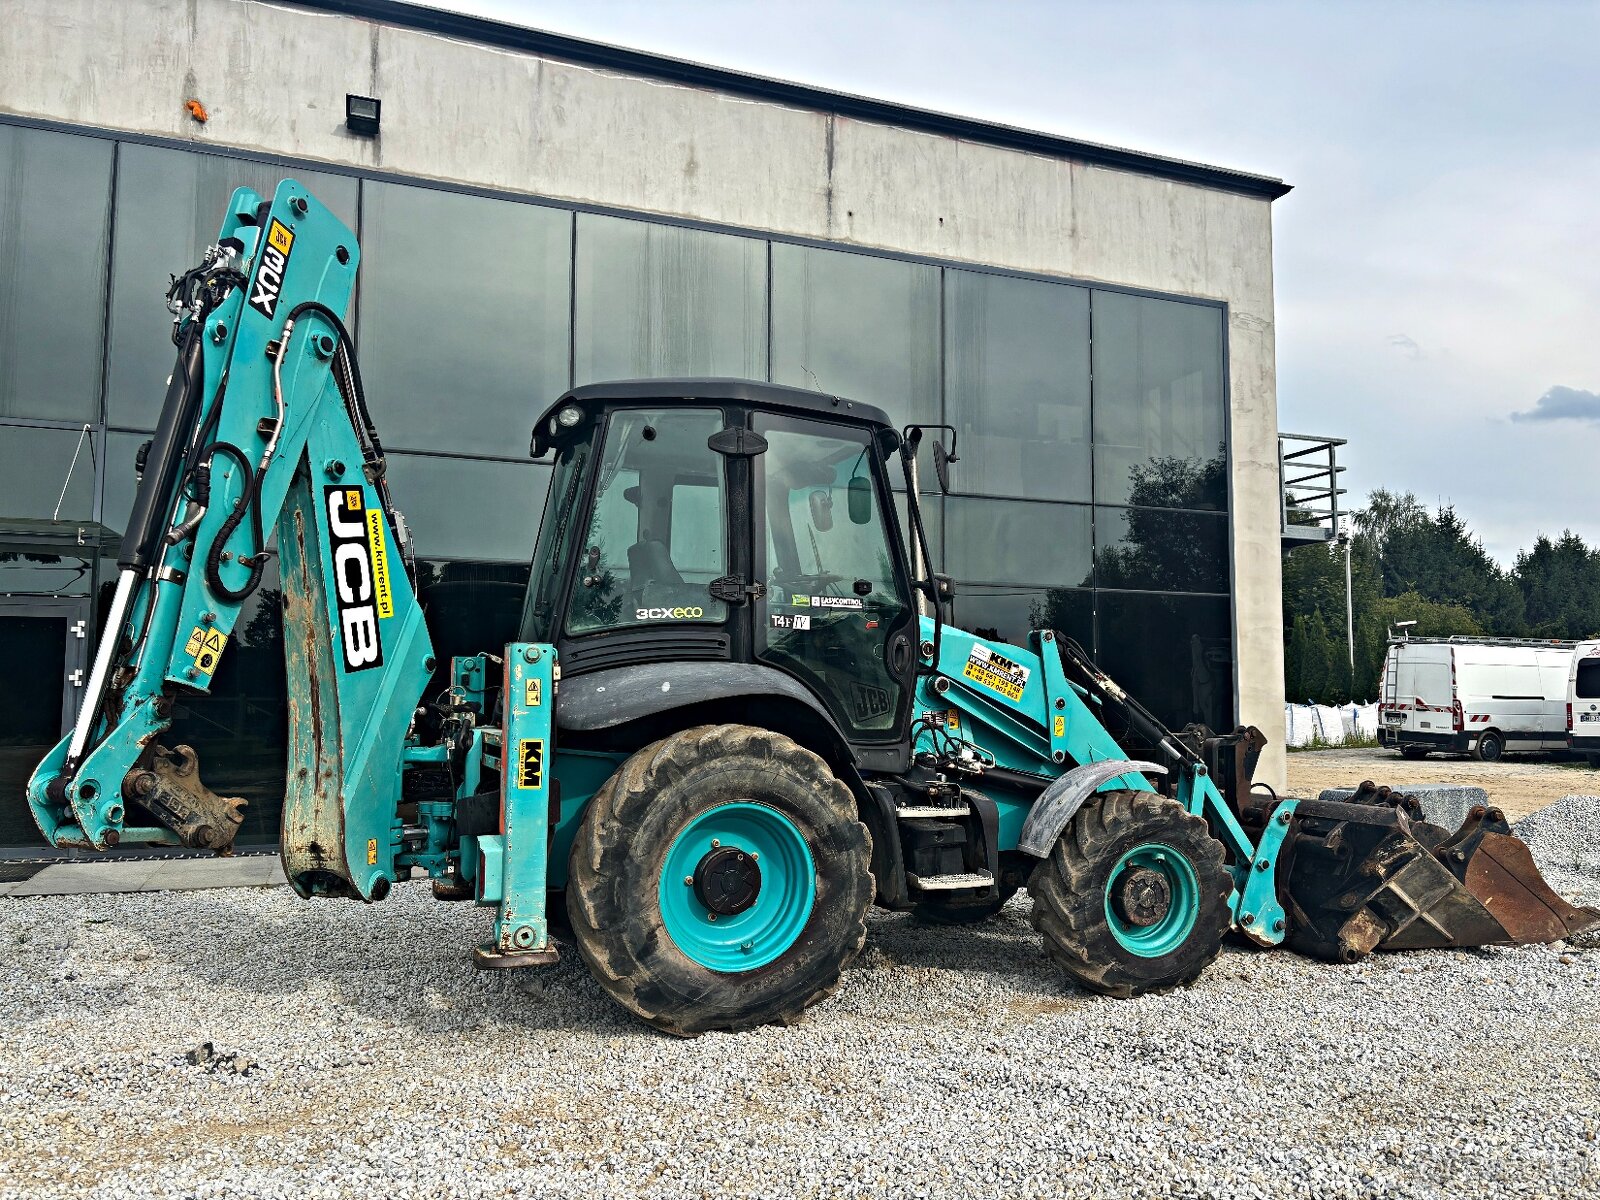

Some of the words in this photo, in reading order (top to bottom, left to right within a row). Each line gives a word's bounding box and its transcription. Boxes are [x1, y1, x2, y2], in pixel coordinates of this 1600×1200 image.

[251, 246, 285, 315] 3CX
[328, 490, 378, 667] JCB
[370, 512, 391, 615] www.kmrent.pl
[990, 651, 1013, 670] KM
[856, 686, 886, 718] JCB
[523, 741, 542, 787] KM
